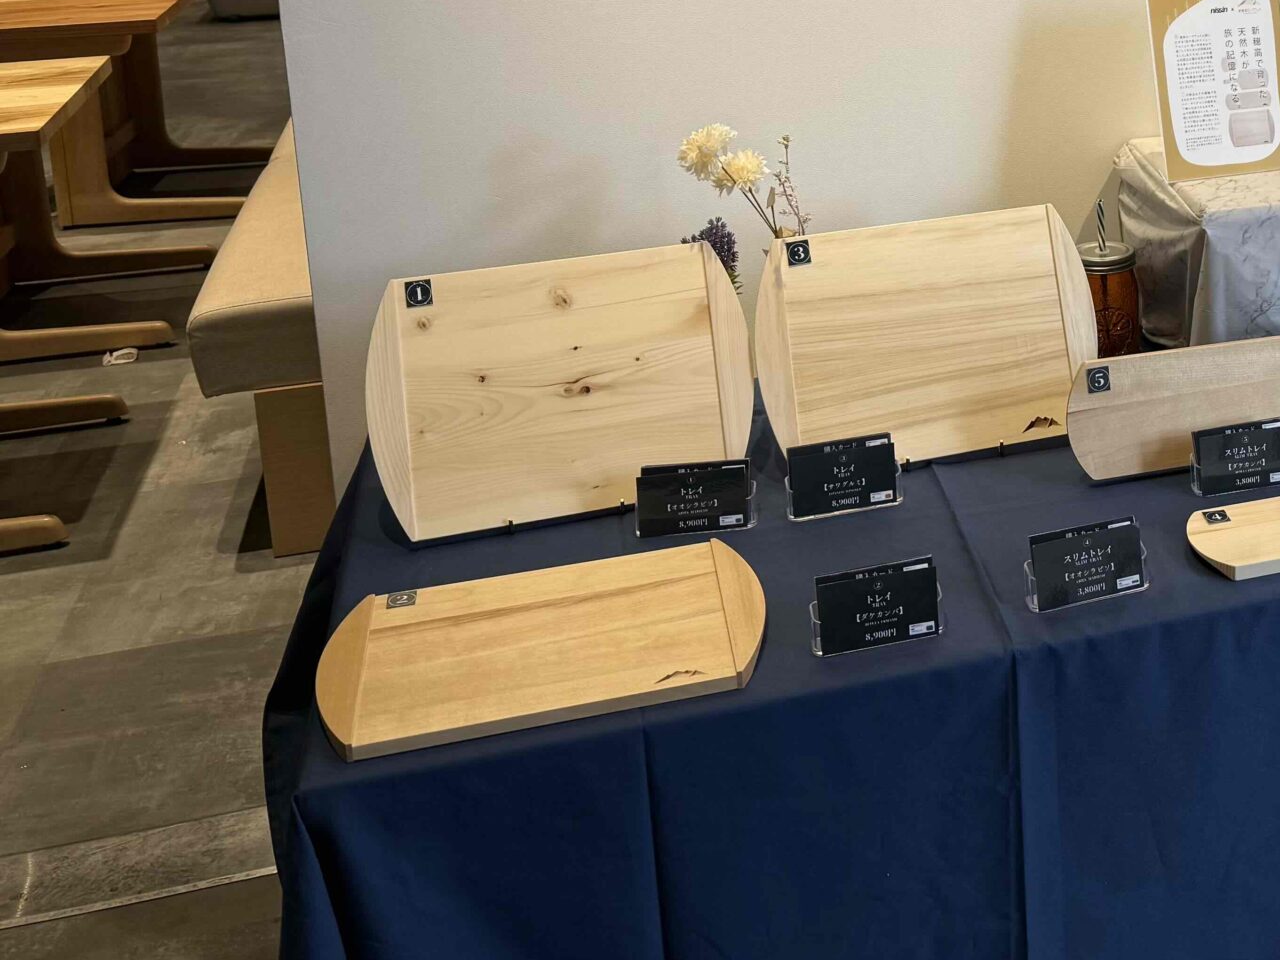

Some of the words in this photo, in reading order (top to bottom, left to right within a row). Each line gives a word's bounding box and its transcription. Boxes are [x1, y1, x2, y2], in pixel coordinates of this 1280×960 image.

[1237, 27, 1249, 69] 天然木が
[1252, 26, 1269, 99] 新穂高で育った
[1225, 444, 1267, 456] スリムトレイ
[834, 464, 855, 474] トレイ
[1228, 459, 1265, 471] 【ダケカンバ】
[1236, 476, 1260, 486] 3,800円
[681, 486, 703, 496] トレイ
[832, 496, 859, 507] 8,900円
[679, 518, 708, 529] 8,900円
[1064, 545, 1112, 564] スリムトレイ
[1065, 562, 1115, 581] 【オオシラビソ】
[1078, 582, 1106, 596] 3,800円
[867, 592, 891, 604] トレイ
[856, 606, 903, 623] 【ダケカンバ】
[865, 628, 896, 641] 8,900円
